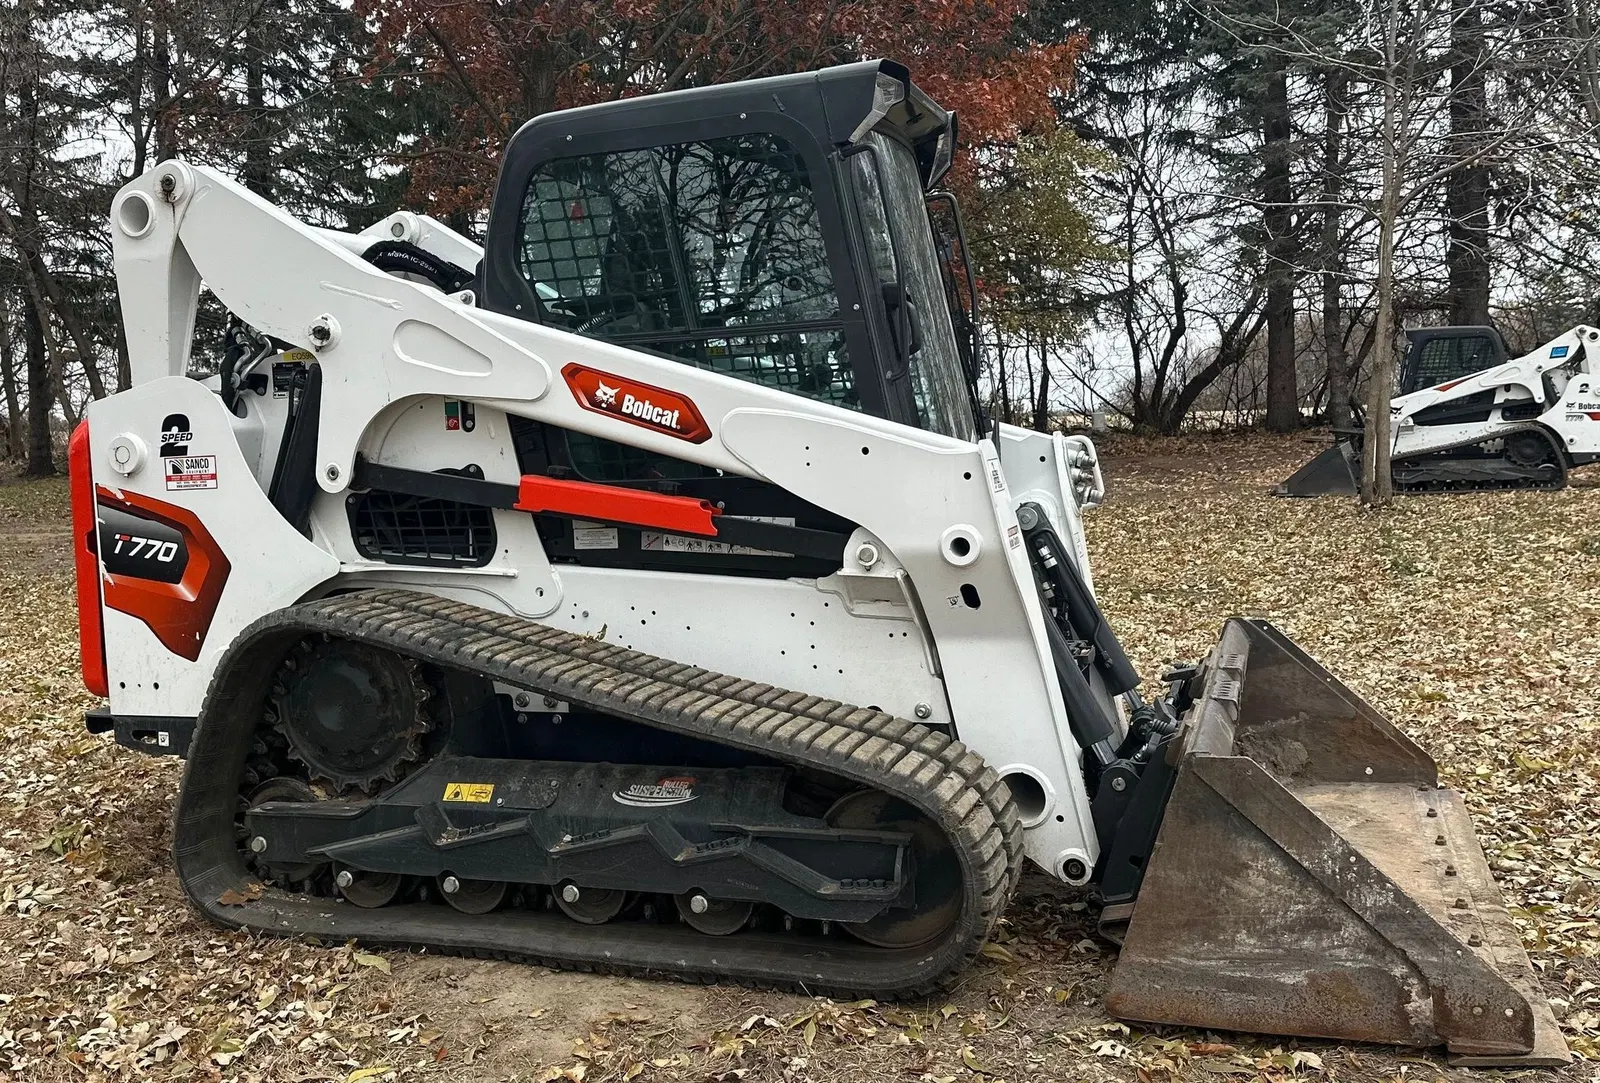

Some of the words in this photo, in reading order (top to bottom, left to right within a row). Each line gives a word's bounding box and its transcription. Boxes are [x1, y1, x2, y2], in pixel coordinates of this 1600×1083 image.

[1578, 383, 1590, 393] 2
[621, 393, 680, 429] Bobcat
[160, 413, 190, 457] 2
[160, 432, 193, 443] SPEED
[185, 458, 210, 469] SANCO
[114, 533, 179, 563] T770
[626, 784, 692, 799] SUSPENSION
